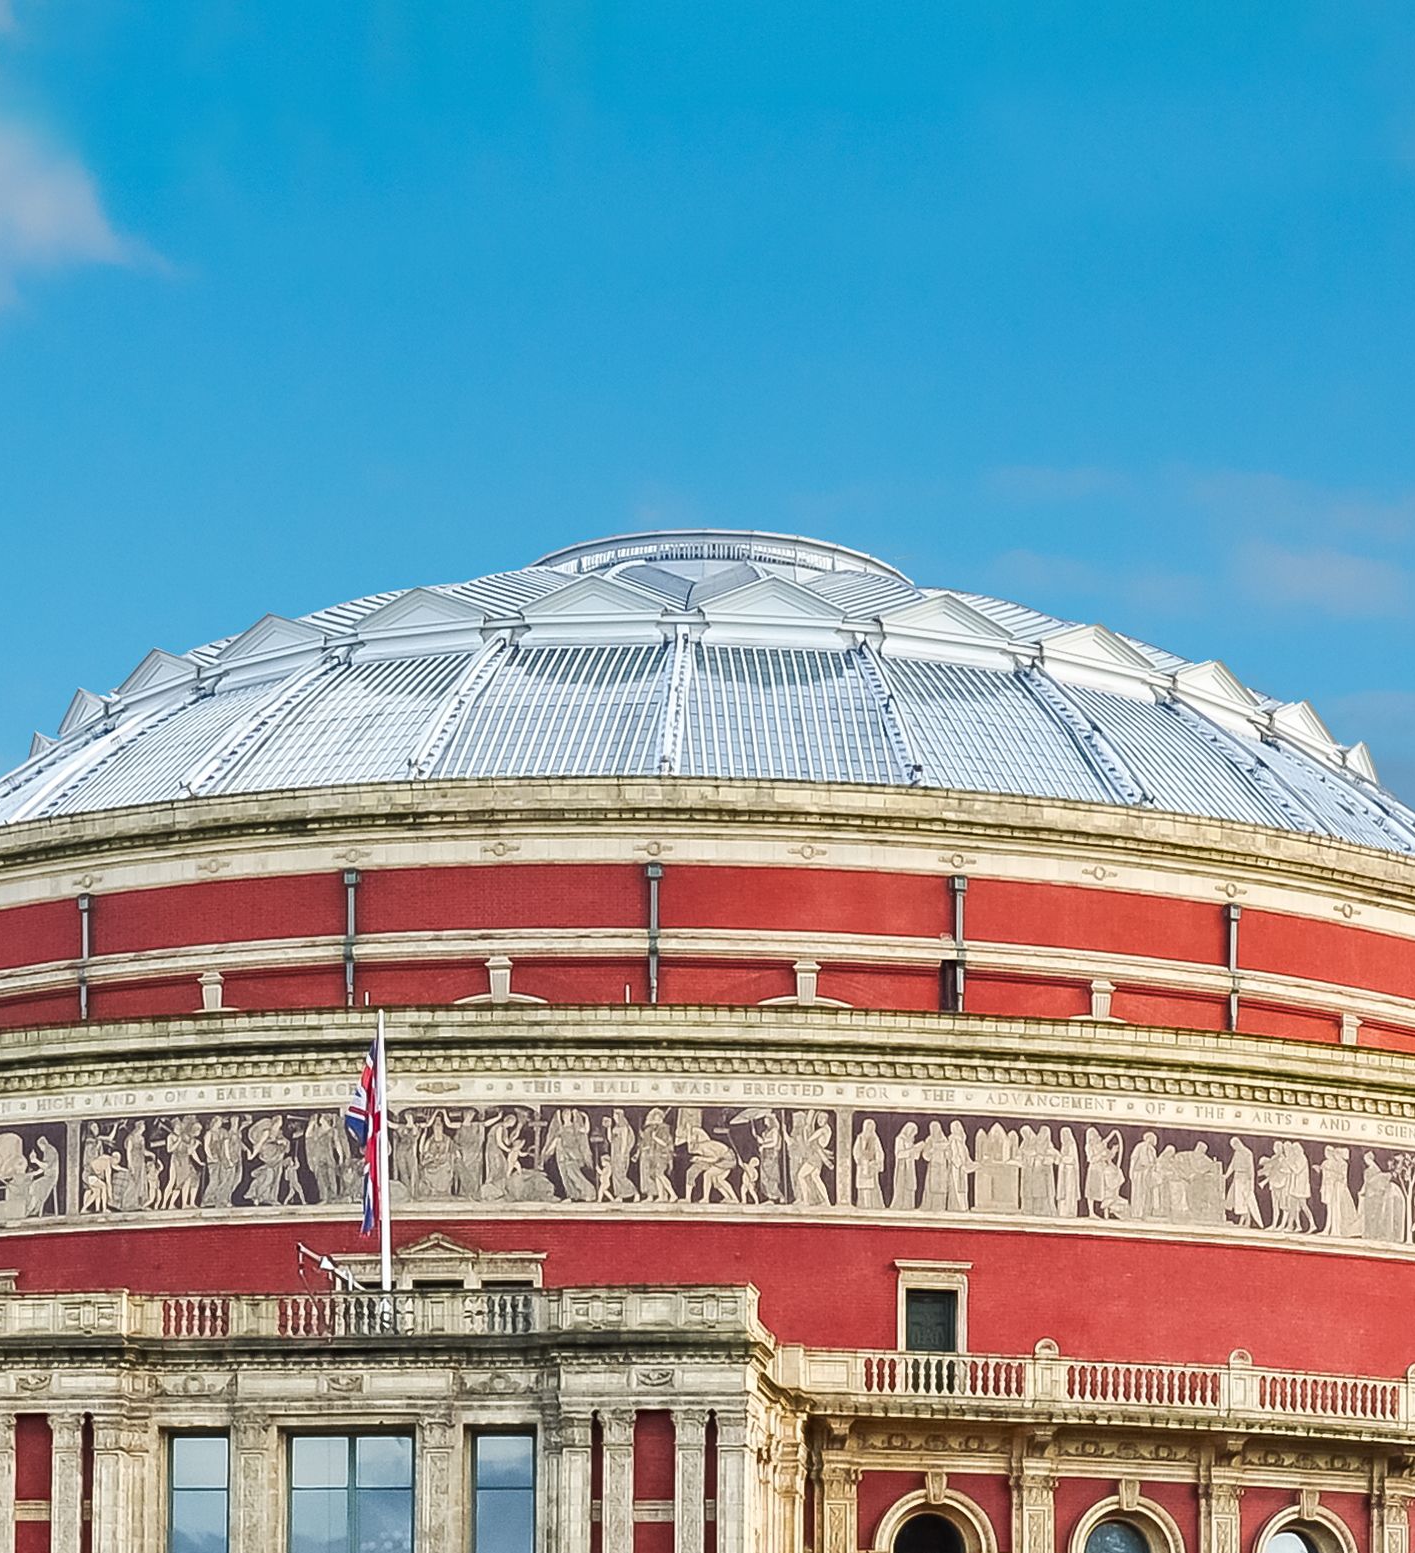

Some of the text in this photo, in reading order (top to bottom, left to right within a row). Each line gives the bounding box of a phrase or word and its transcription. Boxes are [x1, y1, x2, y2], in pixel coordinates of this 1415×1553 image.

[36, 1096, 75, 1112] HIGH
[102, 1093, 136, 1108] AND
[164, 1089, 186, 1103] ON
[216, 1086, 272, 1101] EARTH
[522, 1080, 562, 1094] THIS
[593, 1080, 640, 1094] HALL
[671, 1081, 712, 1094] WAS
[743, 1083, 825, 1097] ERECTED
[855, 1085, 890, 1100] FOR
[921, 1088, 955, 1102] THE
[985, 1091, 1117, 1112] ADVANCEMENT
[1144, 1101, 1166, 1116] OF
[1194, 1105, 1225, 1120] THE
[1252, 1110, 1293, 1126] ARTS
[1319, 1118, 1351, 1132] AND
